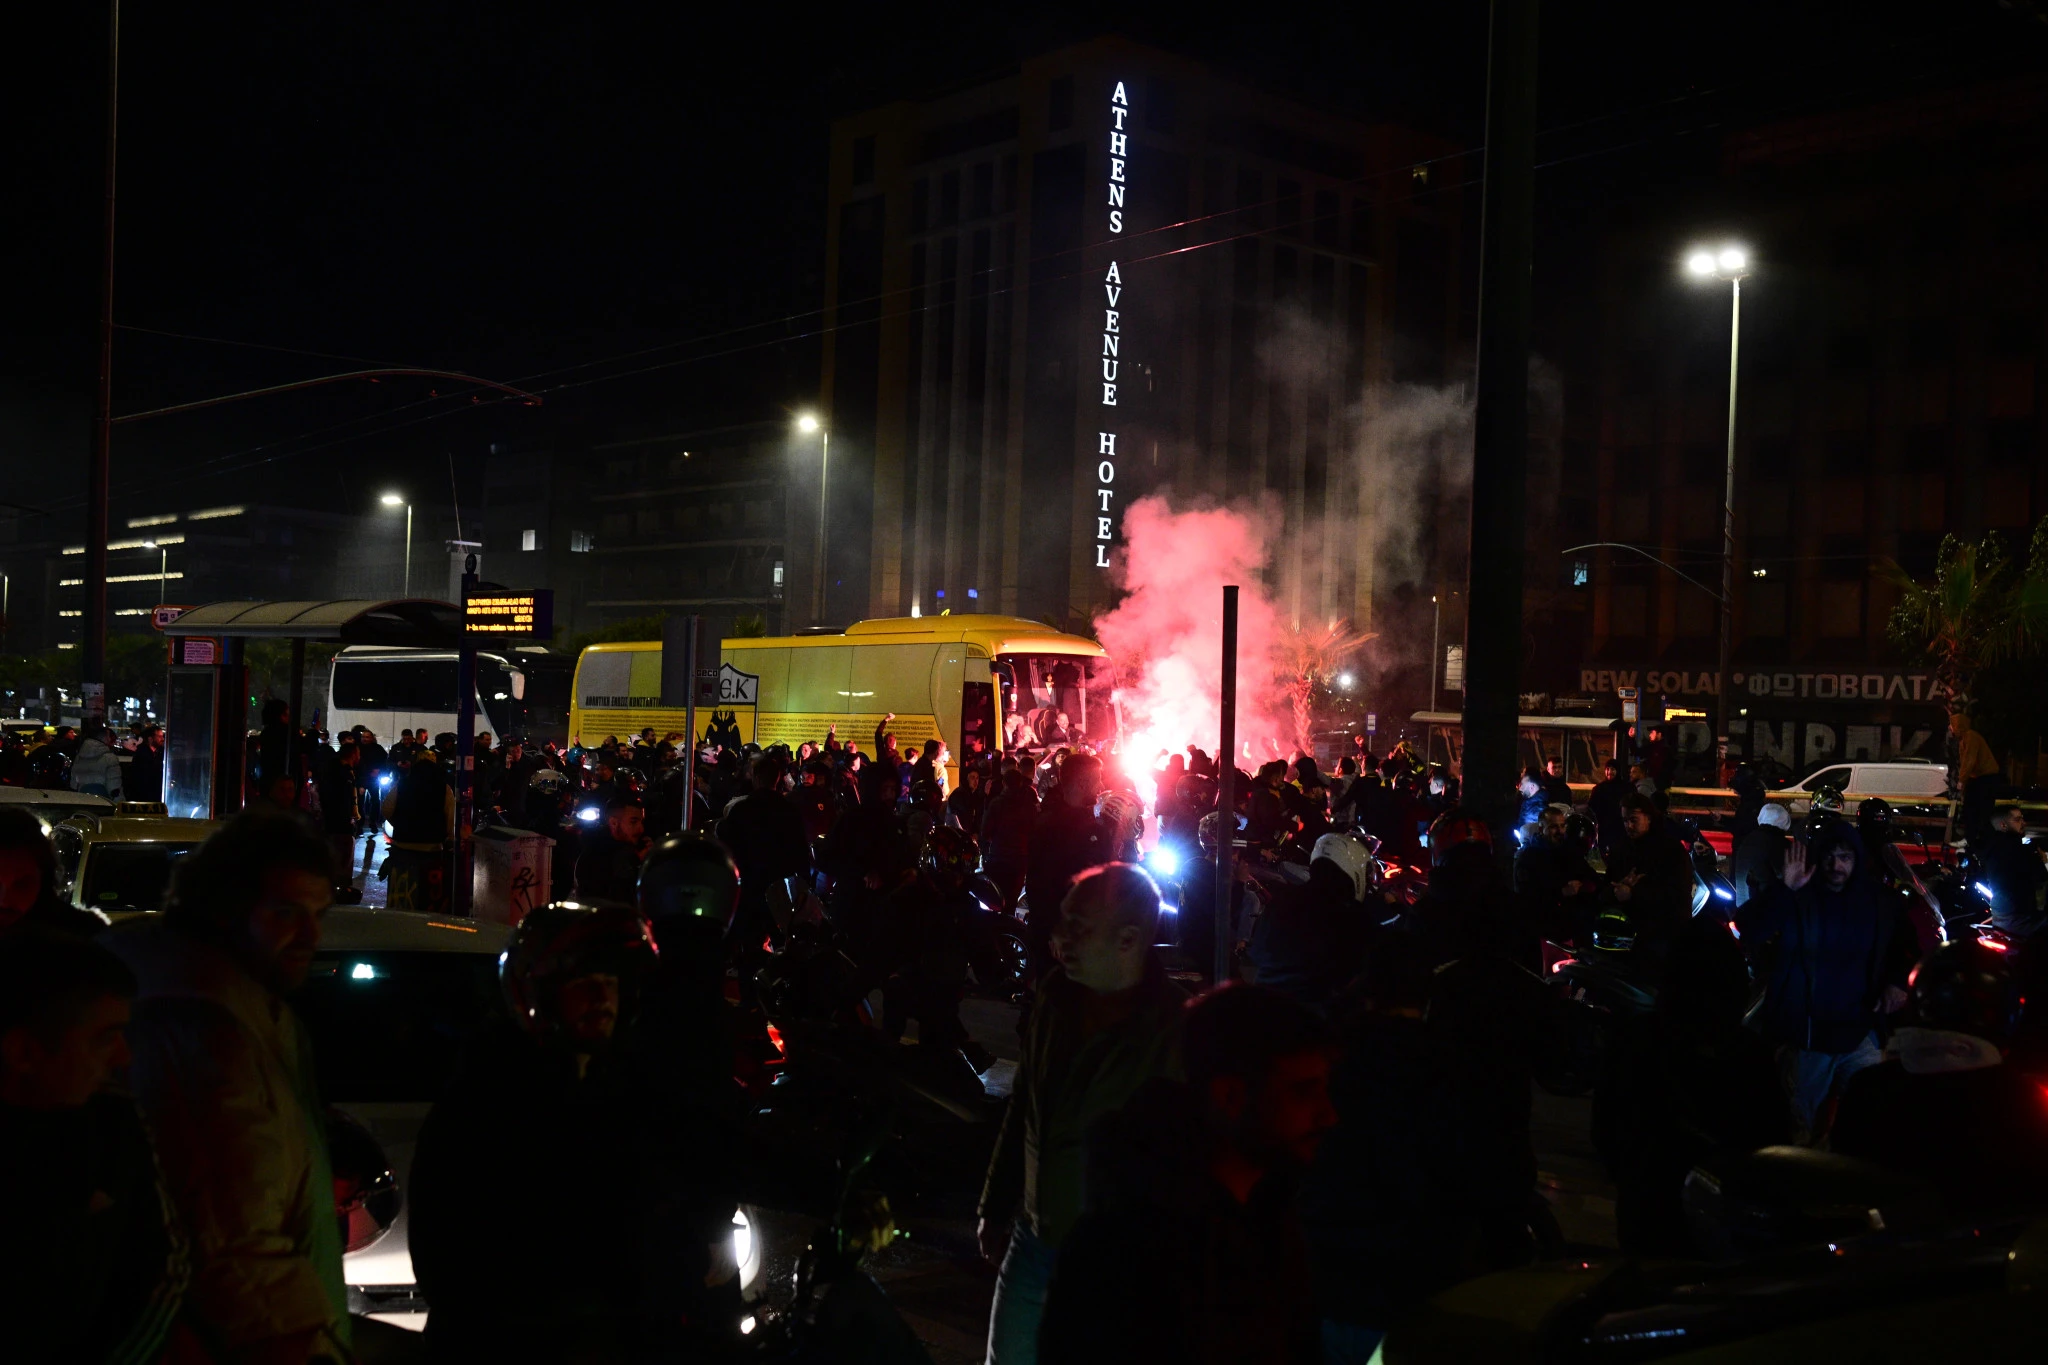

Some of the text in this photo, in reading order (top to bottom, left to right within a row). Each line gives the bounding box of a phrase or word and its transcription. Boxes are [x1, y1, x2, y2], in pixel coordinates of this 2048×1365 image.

[1096, 81, 1129, 568] ATHENS AVENUE HOTEL
[1580, 669, 1639, 693] REW
[1748, 672, 1945, 702] ΦΩΤΟΒΟΛΤΑ
